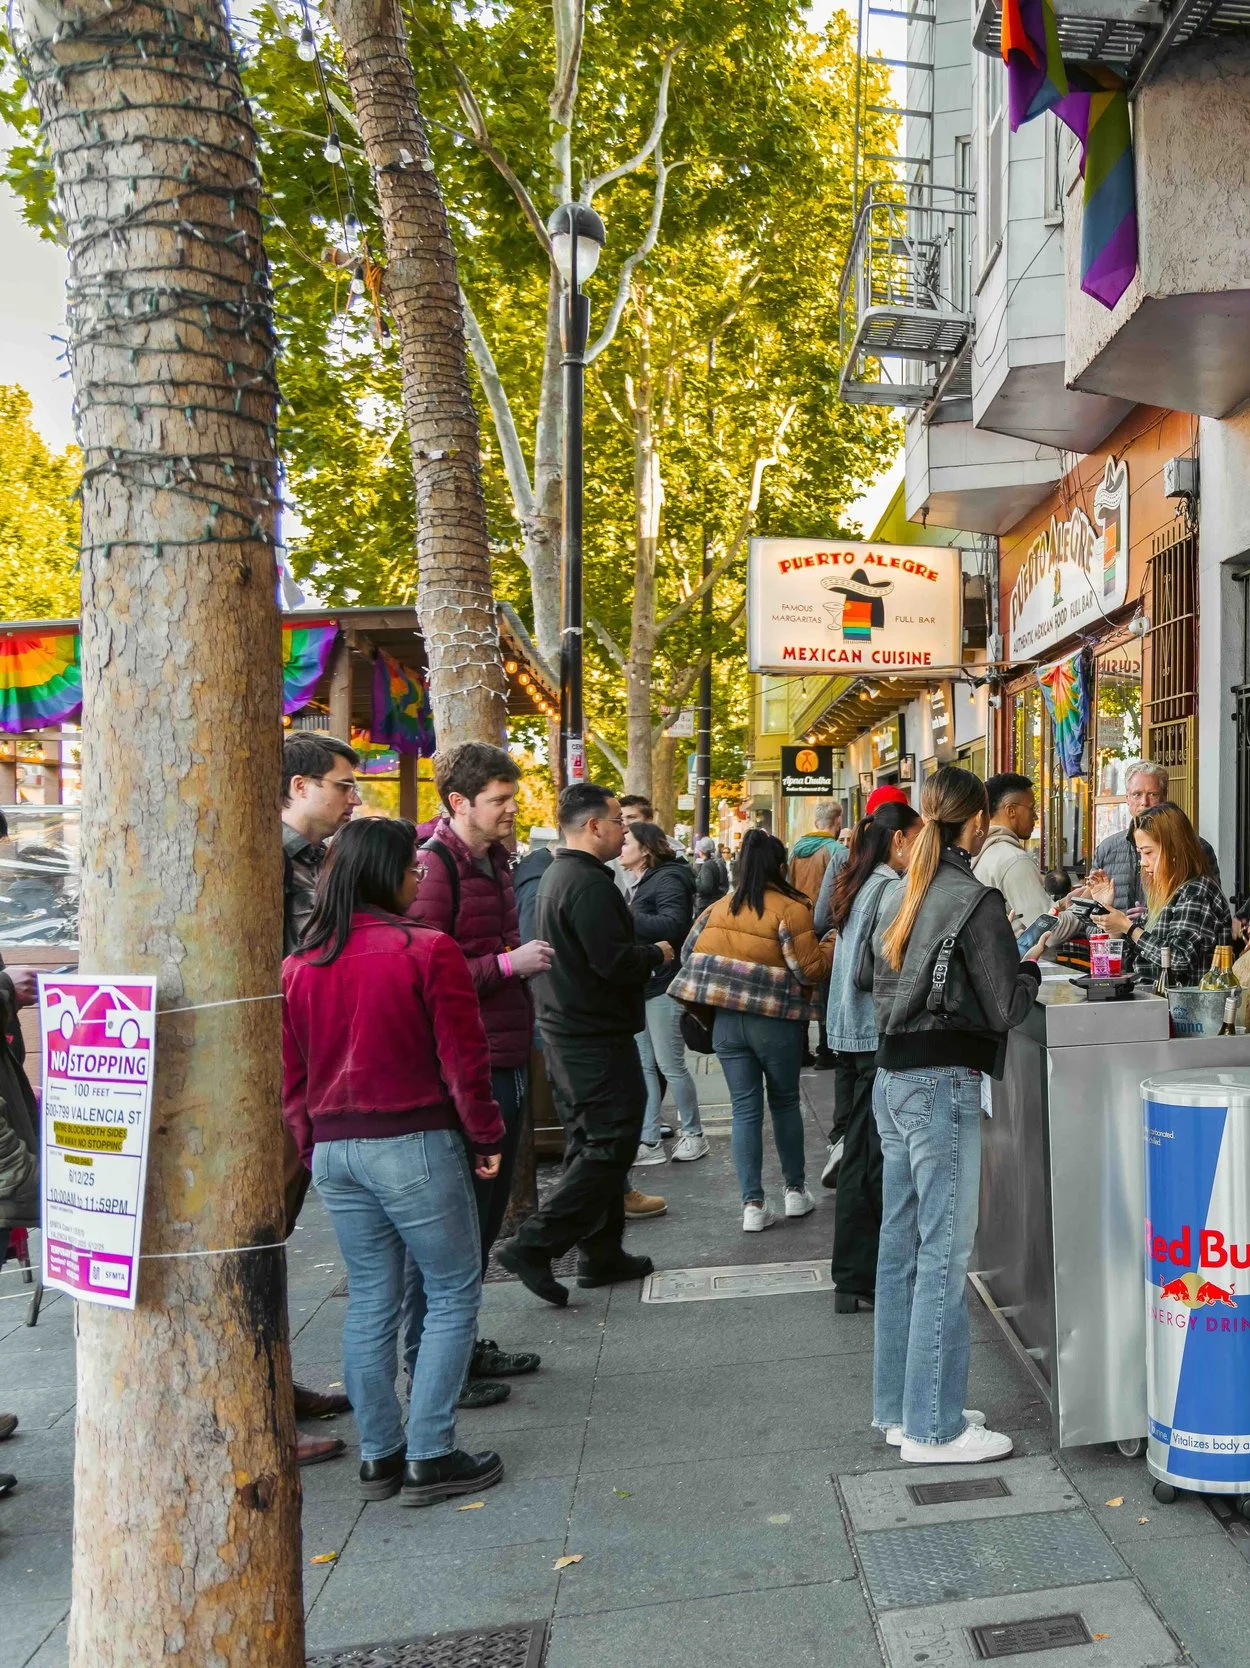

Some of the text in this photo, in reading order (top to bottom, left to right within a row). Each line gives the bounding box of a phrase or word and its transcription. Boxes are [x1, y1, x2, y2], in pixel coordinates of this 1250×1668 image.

[778, 552, 939, 582] PUERTO ALEGRE
[1010, 507, 1098, 633] PUERTO ALEGRE
[781, 603, 814, 612] FAMOUS
[771, 615, 822, 624] MARGARITAS
[895, 615, 936, 624] FULL BAR
[1054, 607, 1068, 630] FOOD
[783, 646, 932, 666] MEXICAN CUISINE
[51, 1050, 146, 1075] NO STOPPING
[74, 1083, 110, 1097] 100 FEET
[71, 1105, 124, 1124] VALENCIA
[128, 1110, 142, 1125] ST
[85, 1196, 128, 1215] 11:59PM
[105, 1271, 125, 1280] SFMTA
[1149, 1307, 1198, 1332] NERGY
[1173, 1433, 1209, 1449] Vitalizes
[1213, 1438, 1240, 1454] body
